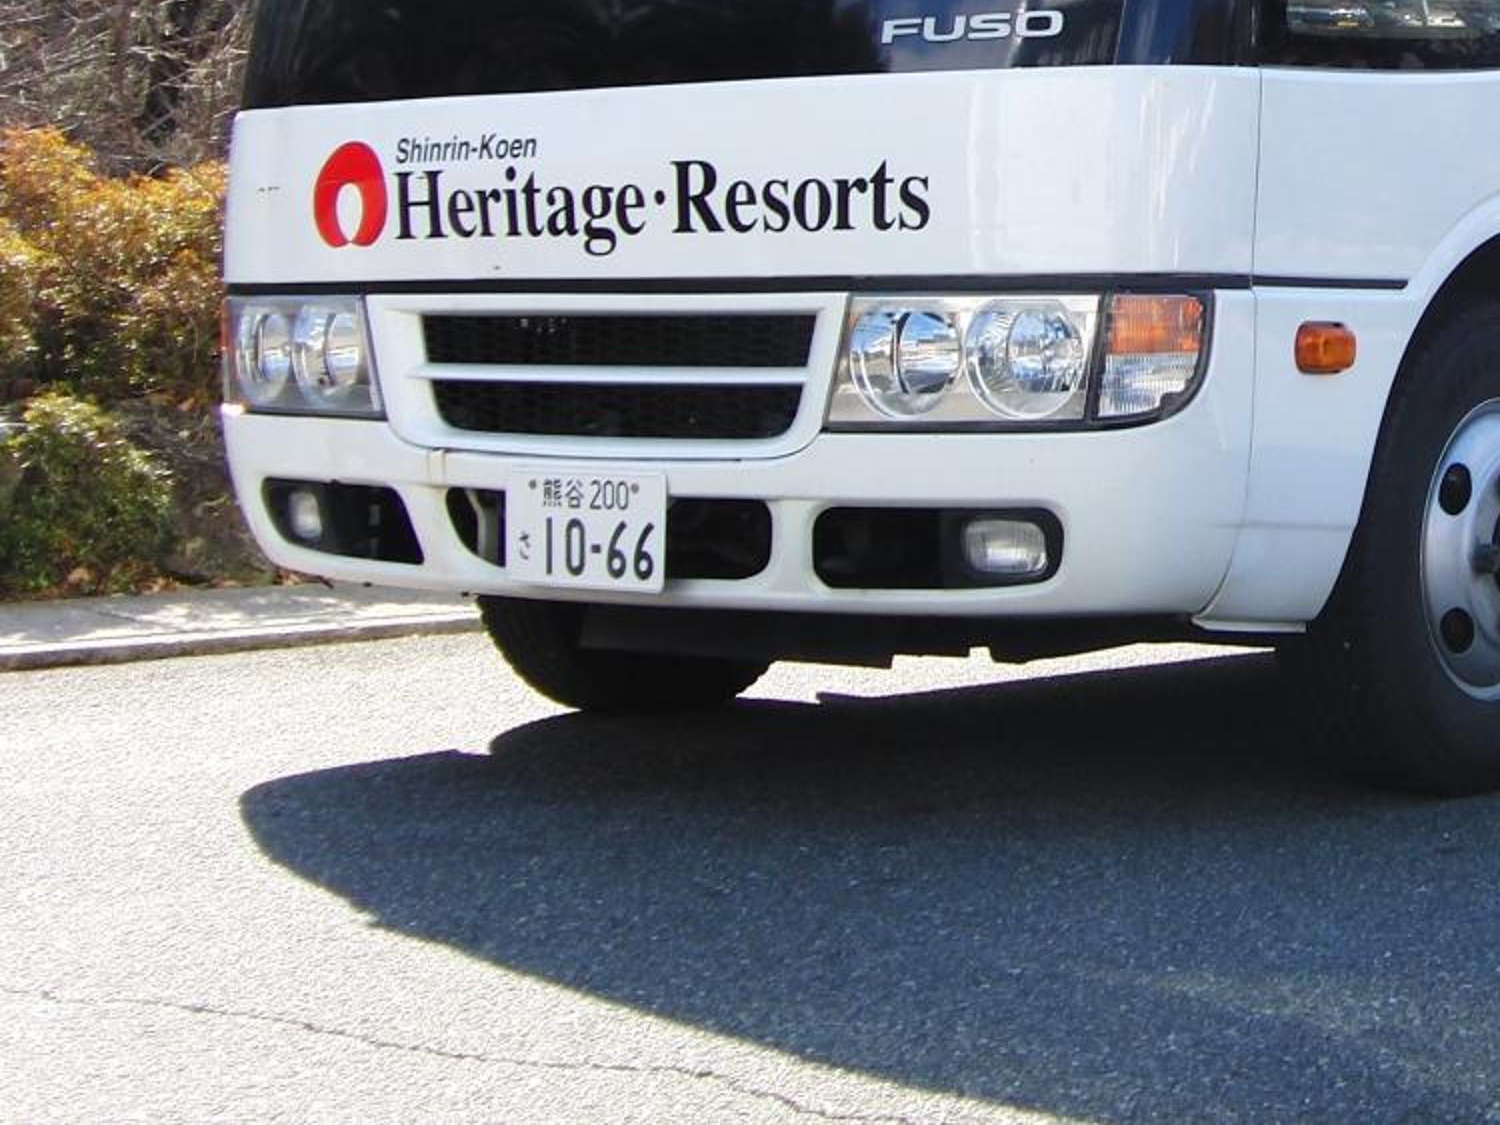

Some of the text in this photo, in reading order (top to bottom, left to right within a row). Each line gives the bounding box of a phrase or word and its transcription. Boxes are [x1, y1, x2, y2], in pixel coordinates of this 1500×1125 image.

[881, 10, 1064, 44] FUSO
[395, 133, 537, 164] Shinrin-Koen
[542, 478, 630, 511] 熊谷 200
[545, 516, 656, 582] 10-66
